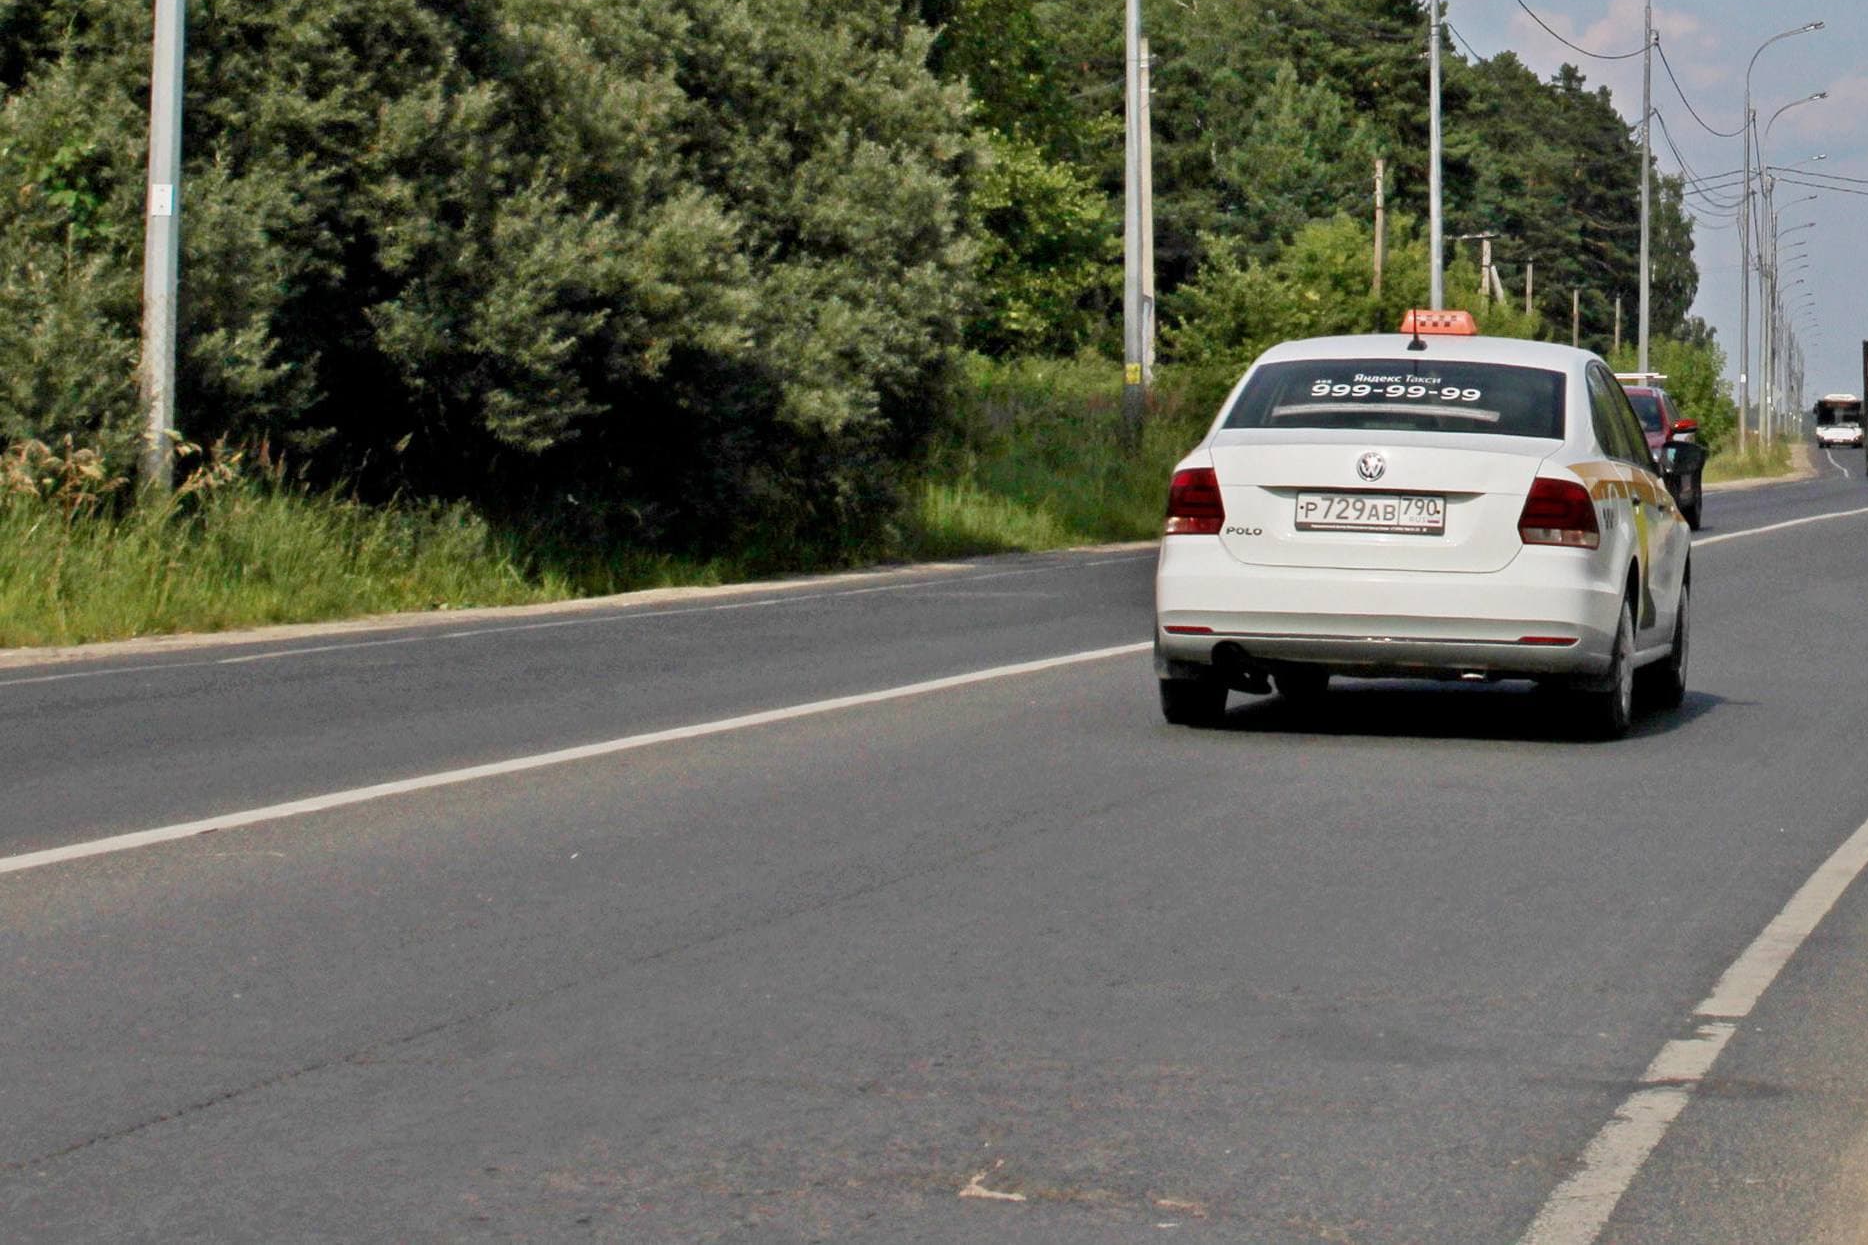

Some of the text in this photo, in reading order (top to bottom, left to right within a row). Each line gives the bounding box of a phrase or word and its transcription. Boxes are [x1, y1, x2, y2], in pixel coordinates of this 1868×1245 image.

[1353, 373, 1442, 385] Яндекс Такси
[1311, 383, 1482, 402] 999-99-99
[1402, 497, 1438, 517] 790
[1226, 526, 1263, 536] POLO
